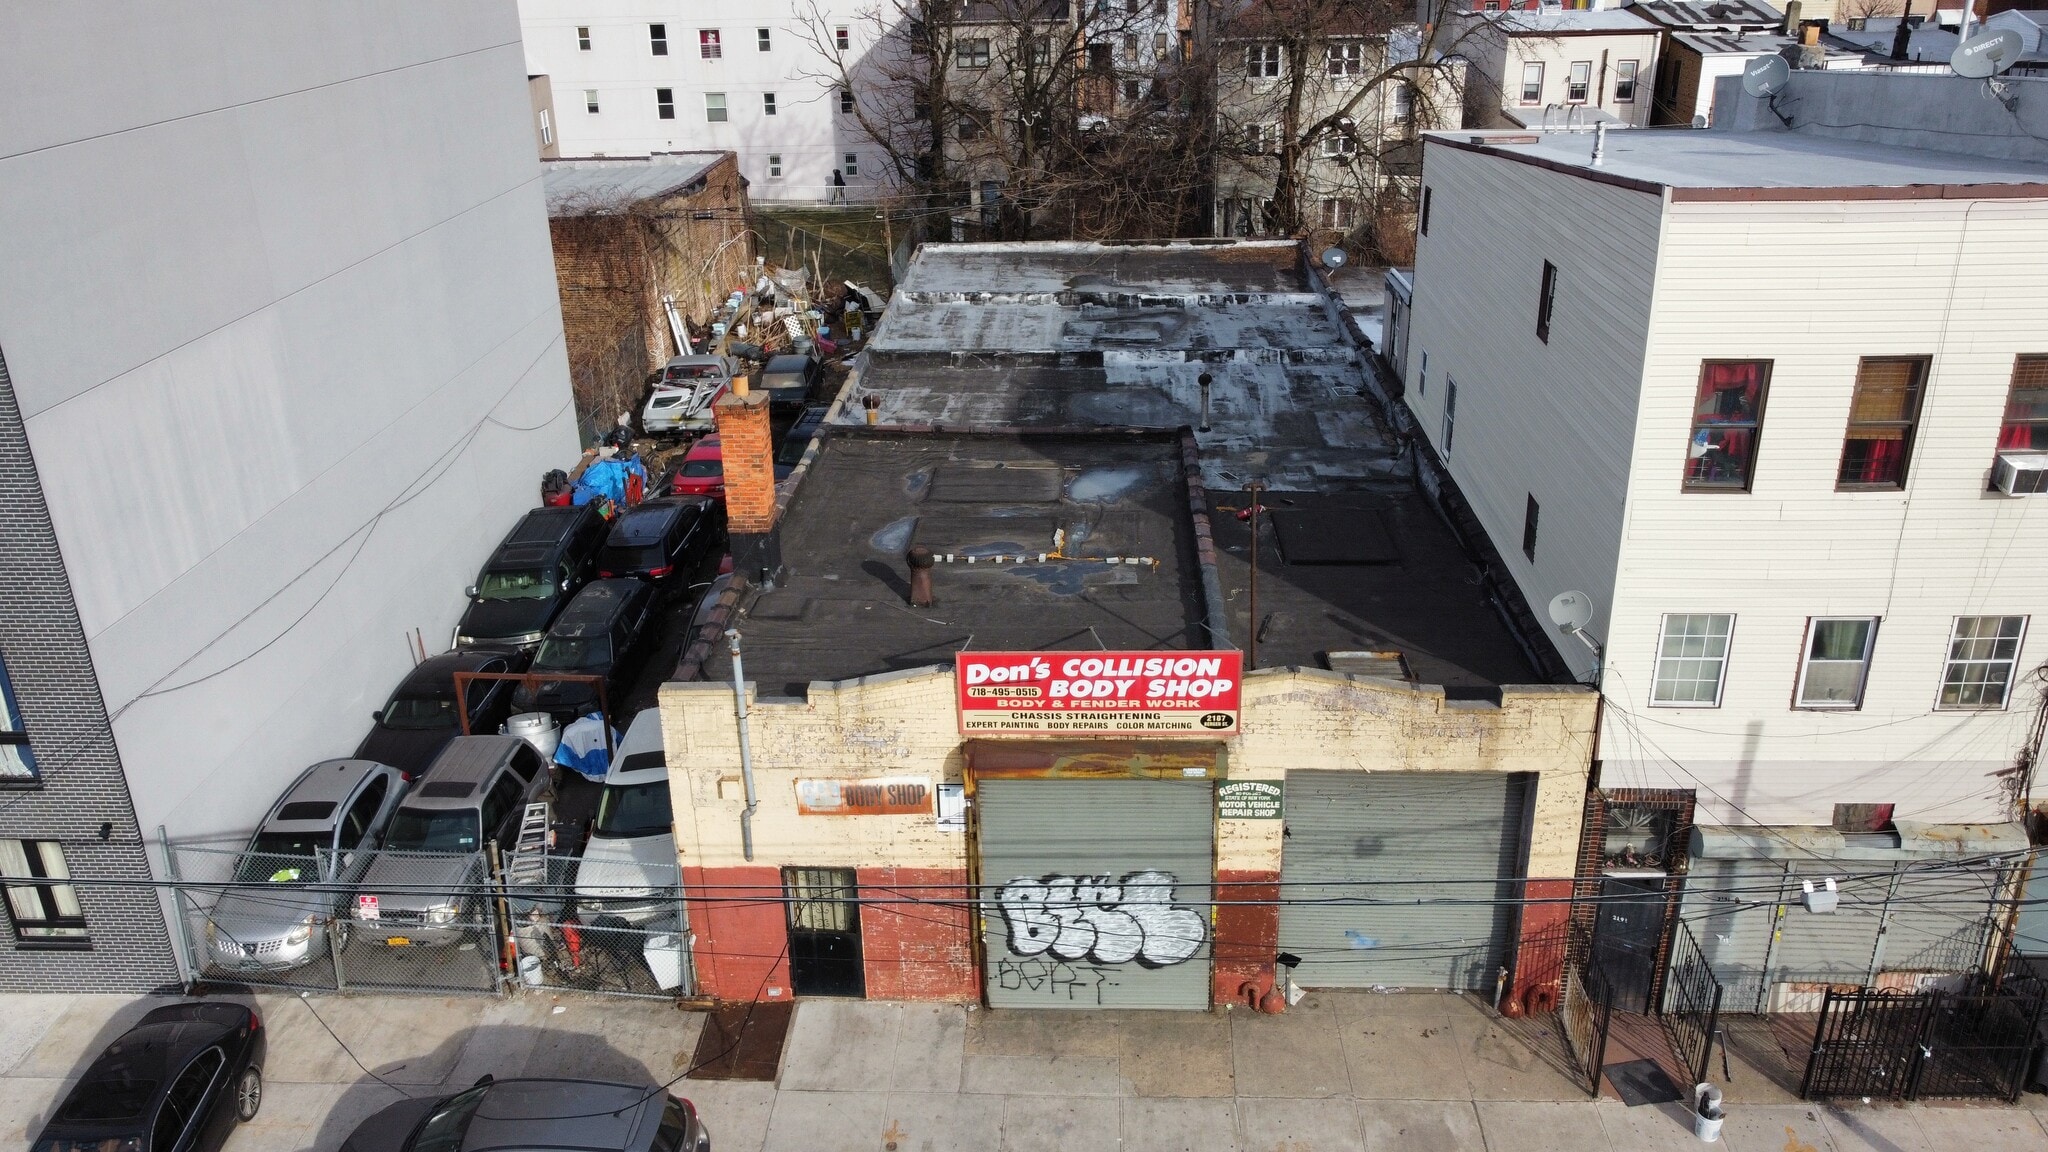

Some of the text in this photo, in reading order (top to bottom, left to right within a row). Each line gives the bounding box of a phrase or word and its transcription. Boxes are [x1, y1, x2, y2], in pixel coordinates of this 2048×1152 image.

[1973, 36, 2003, 52] DIRECTV
[967, 657, 1221, 685] Don's COLLISION
[971, 687, 1038, 697] 718-495-0515
[1049, 679, 1233, 698] BODY SHOP
[997, 699, 1201, 708] BODY & FENDER WORK
[1011, 712, 1161, 720] CHASSIS STRAIGHTENING
[966, 721, 1039, 729] EXPERT PAINTING
[887, 784, 926, 806] SHOP
[1219, 782, 1280, 797] REGISTERED
[1254, 809, 1276, 817] SHOP
